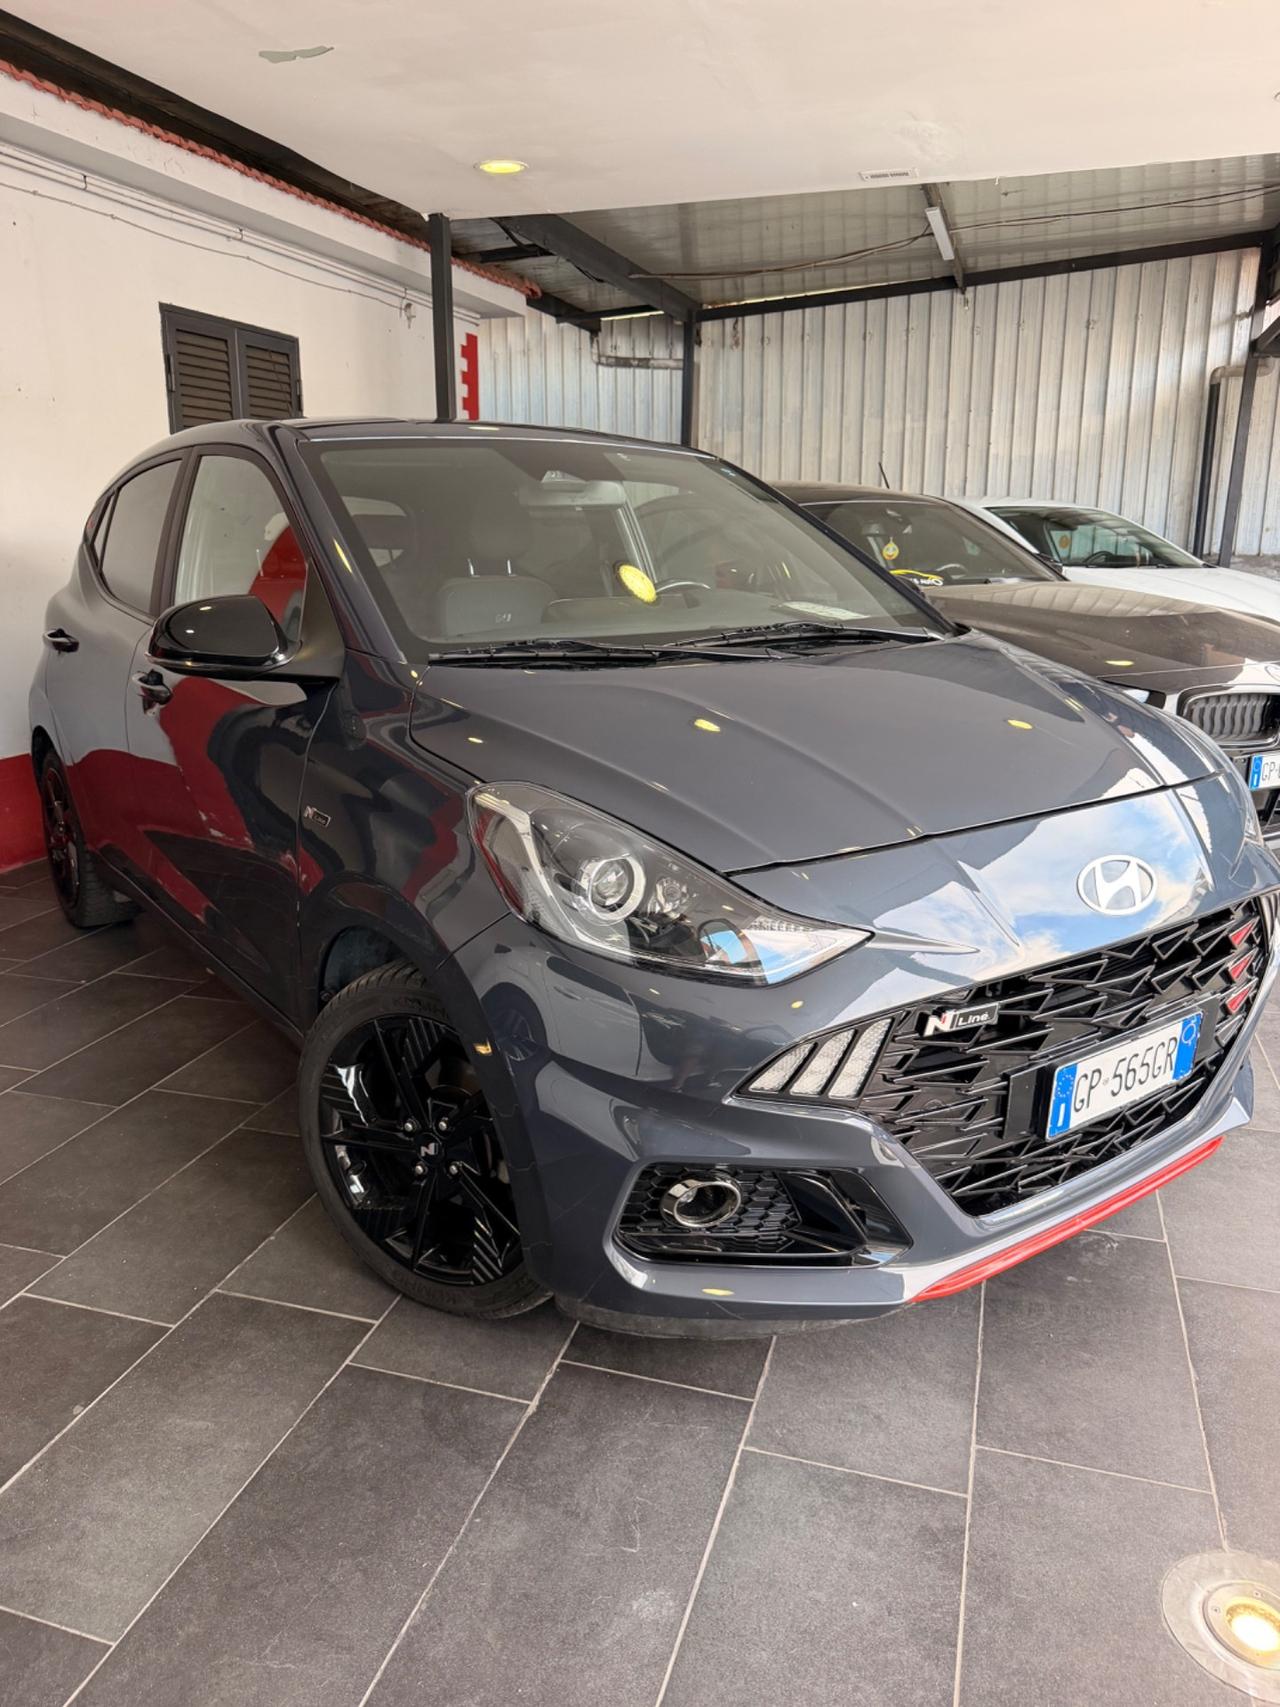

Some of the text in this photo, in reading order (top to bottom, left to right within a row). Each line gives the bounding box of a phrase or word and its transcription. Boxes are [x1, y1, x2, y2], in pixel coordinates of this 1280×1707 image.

[923, 1009, 989, 1037] N Line
[1073, 1036, 1178, 1113] GP 565GR
[420, 1142, 438, 1157] N
